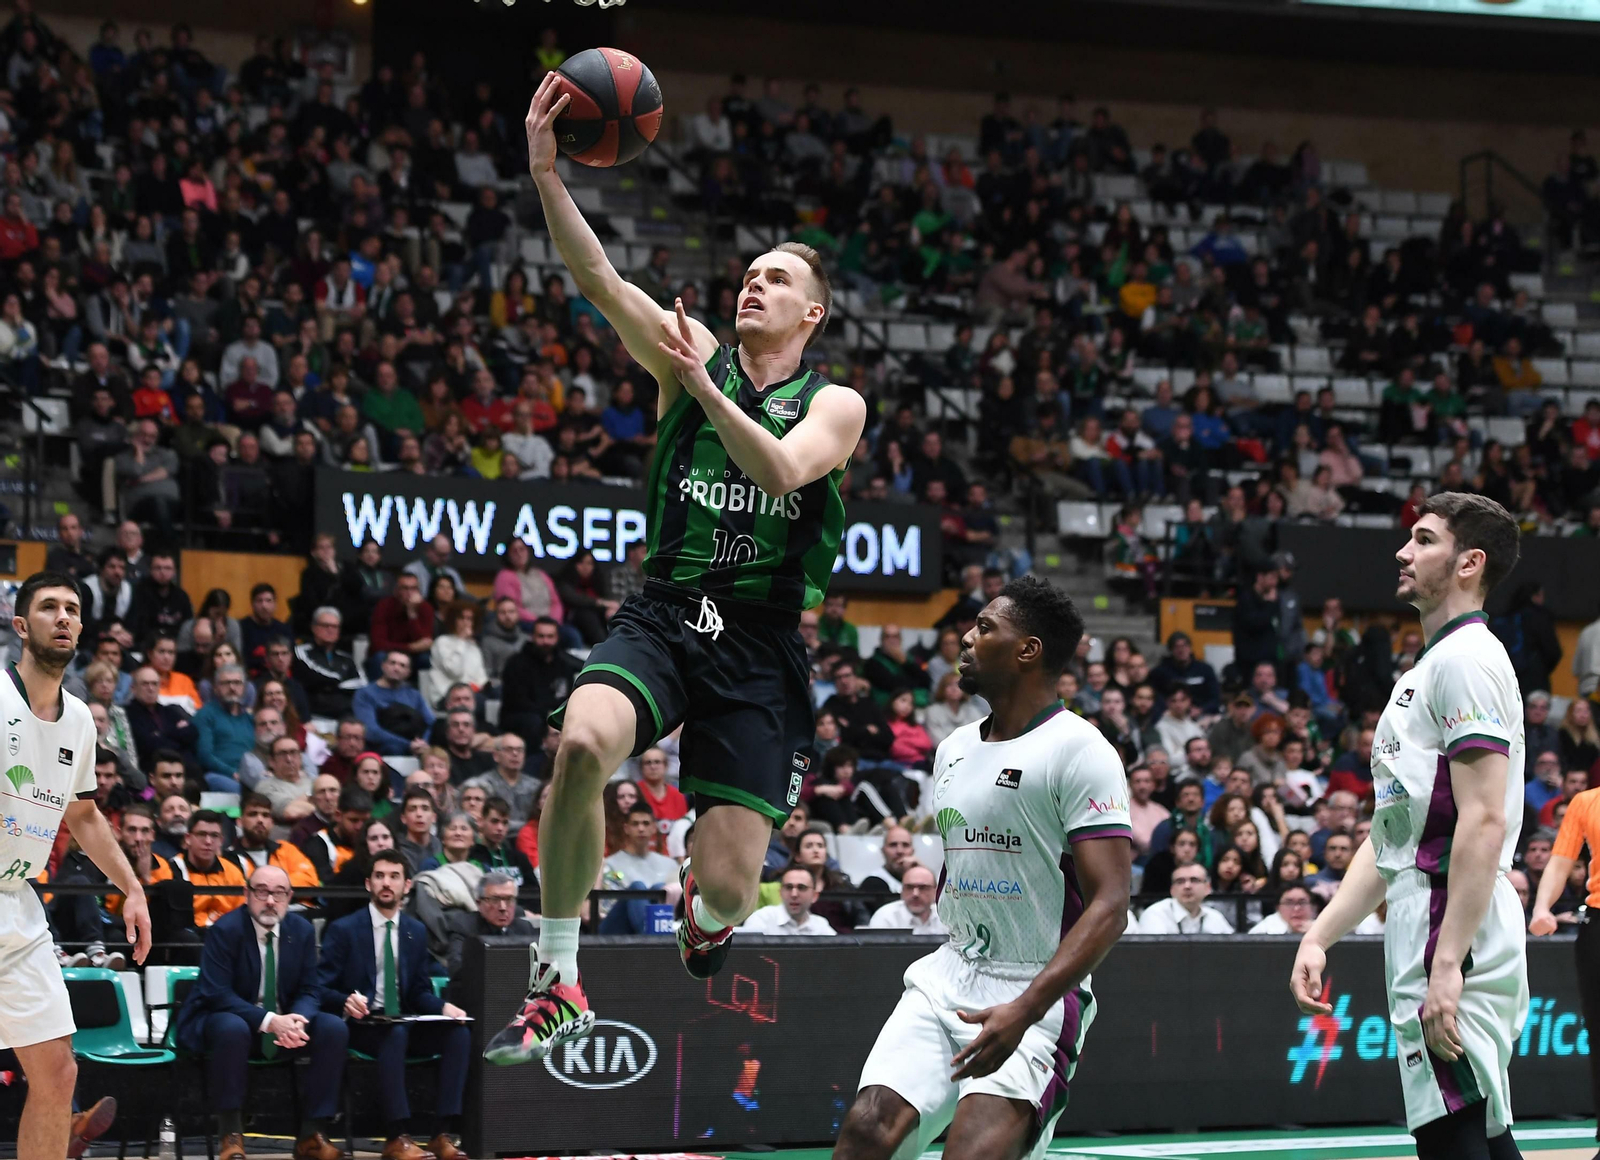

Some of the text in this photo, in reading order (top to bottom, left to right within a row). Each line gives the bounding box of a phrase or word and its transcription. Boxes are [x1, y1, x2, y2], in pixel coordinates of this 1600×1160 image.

[678, 477, 803, 521] PROBITAS
[708, 528, 758, 572] 10
[831, 521, 922, 578] OM
[964, 825, 1023, 850] Unicaja
[563, 1036, 639, 1074] KIA
